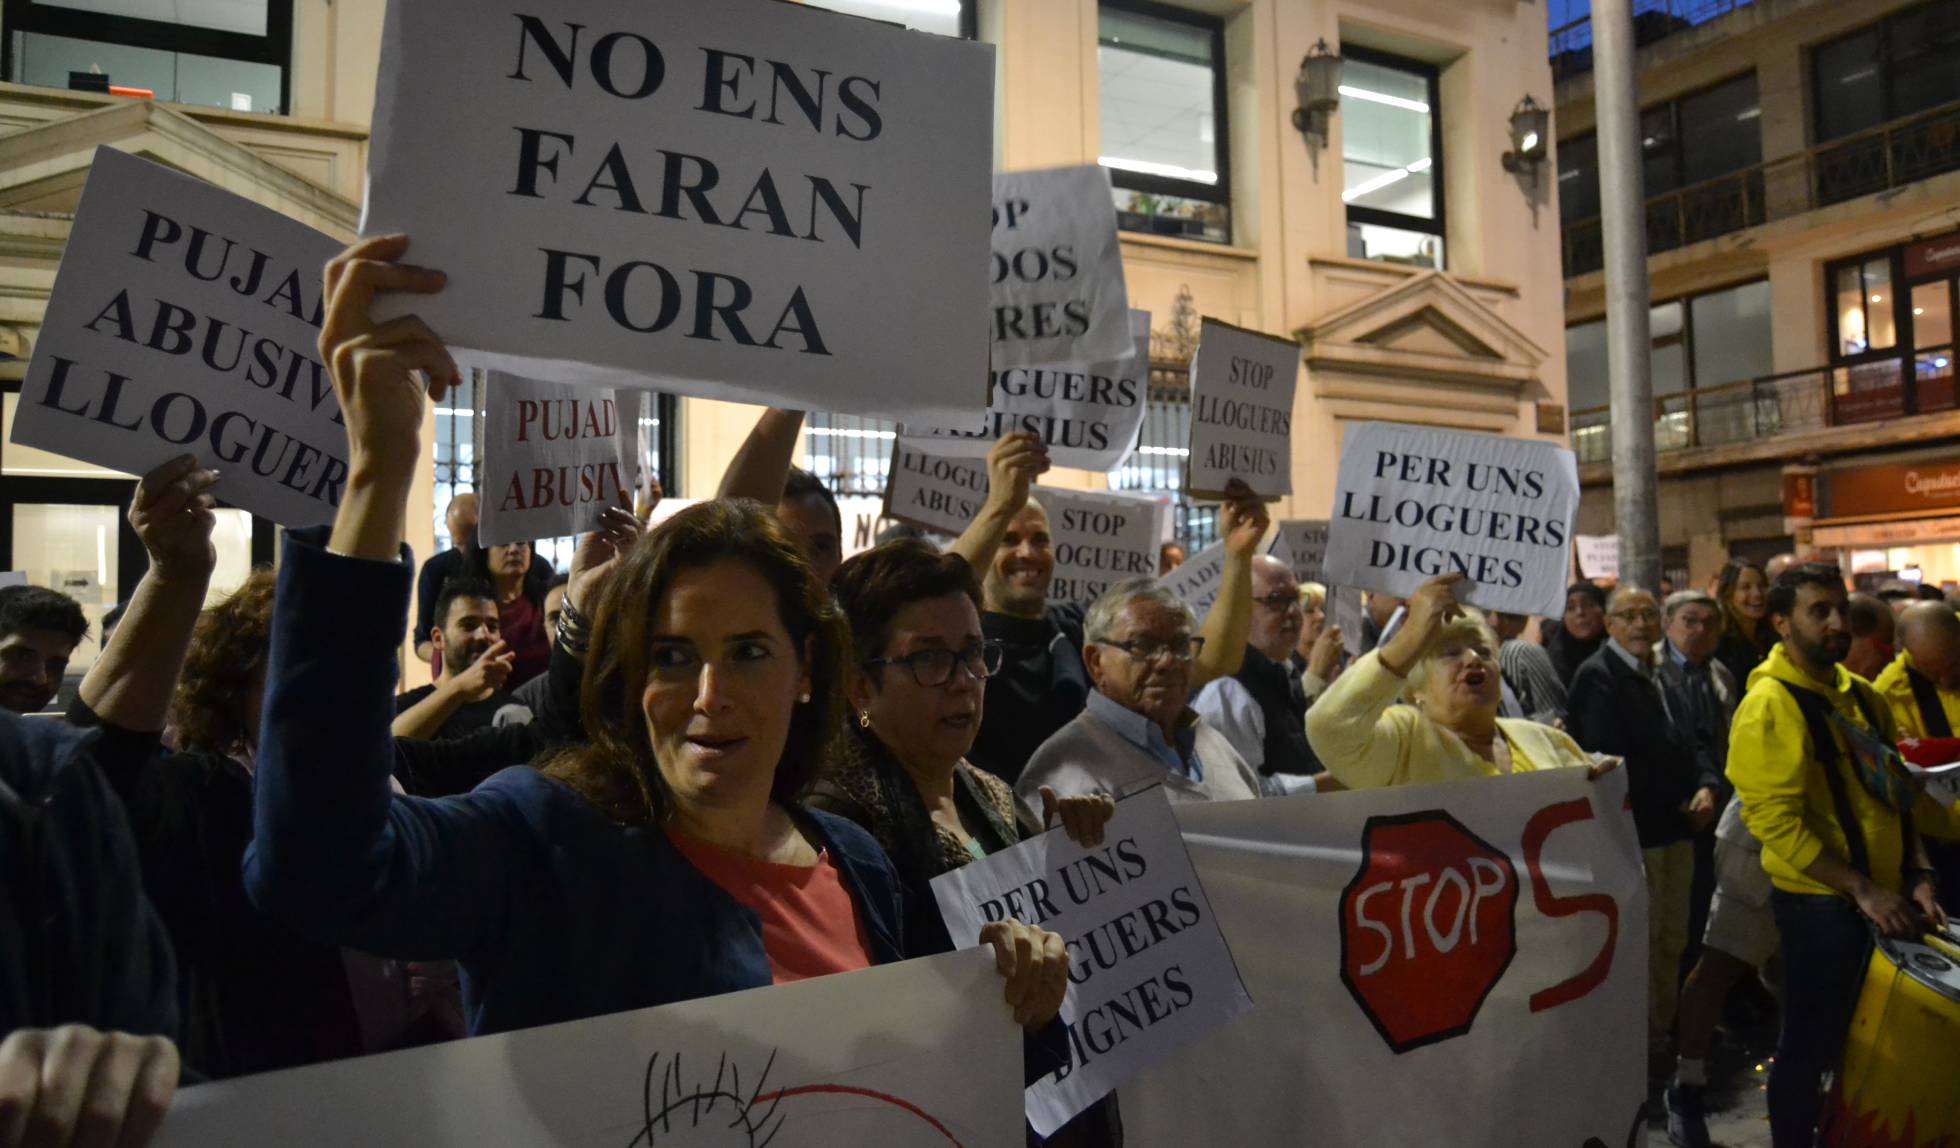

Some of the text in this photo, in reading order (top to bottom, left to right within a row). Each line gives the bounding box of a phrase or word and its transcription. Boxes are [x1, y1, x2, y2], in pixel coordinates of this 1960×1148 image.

[505, 13, 882, 142] NO ENS
[506, 126, 872, 249] FARAN
[532, 247, 833, 356] FORA
[82, 287, 346, 427] ABUSIV
[1229, 355, 1274, 390] STOP
[992, 368, 1137, 408] GUERS
[1198, 394, 1290, 436] LLOGUERS
[1204, 442, 1279, 476] ABUSIUS
[1373, 450, 1544, 500] PER UNS
[1061, 507, 1126, 537] STOP
[1341, 491, 1565, 549] LLOGUERS
[1368, 539, 1524, 589] DIGNES
[978, 836, 1148, 925] PER UNS
[1355, 856, 1507, 977] STOP
